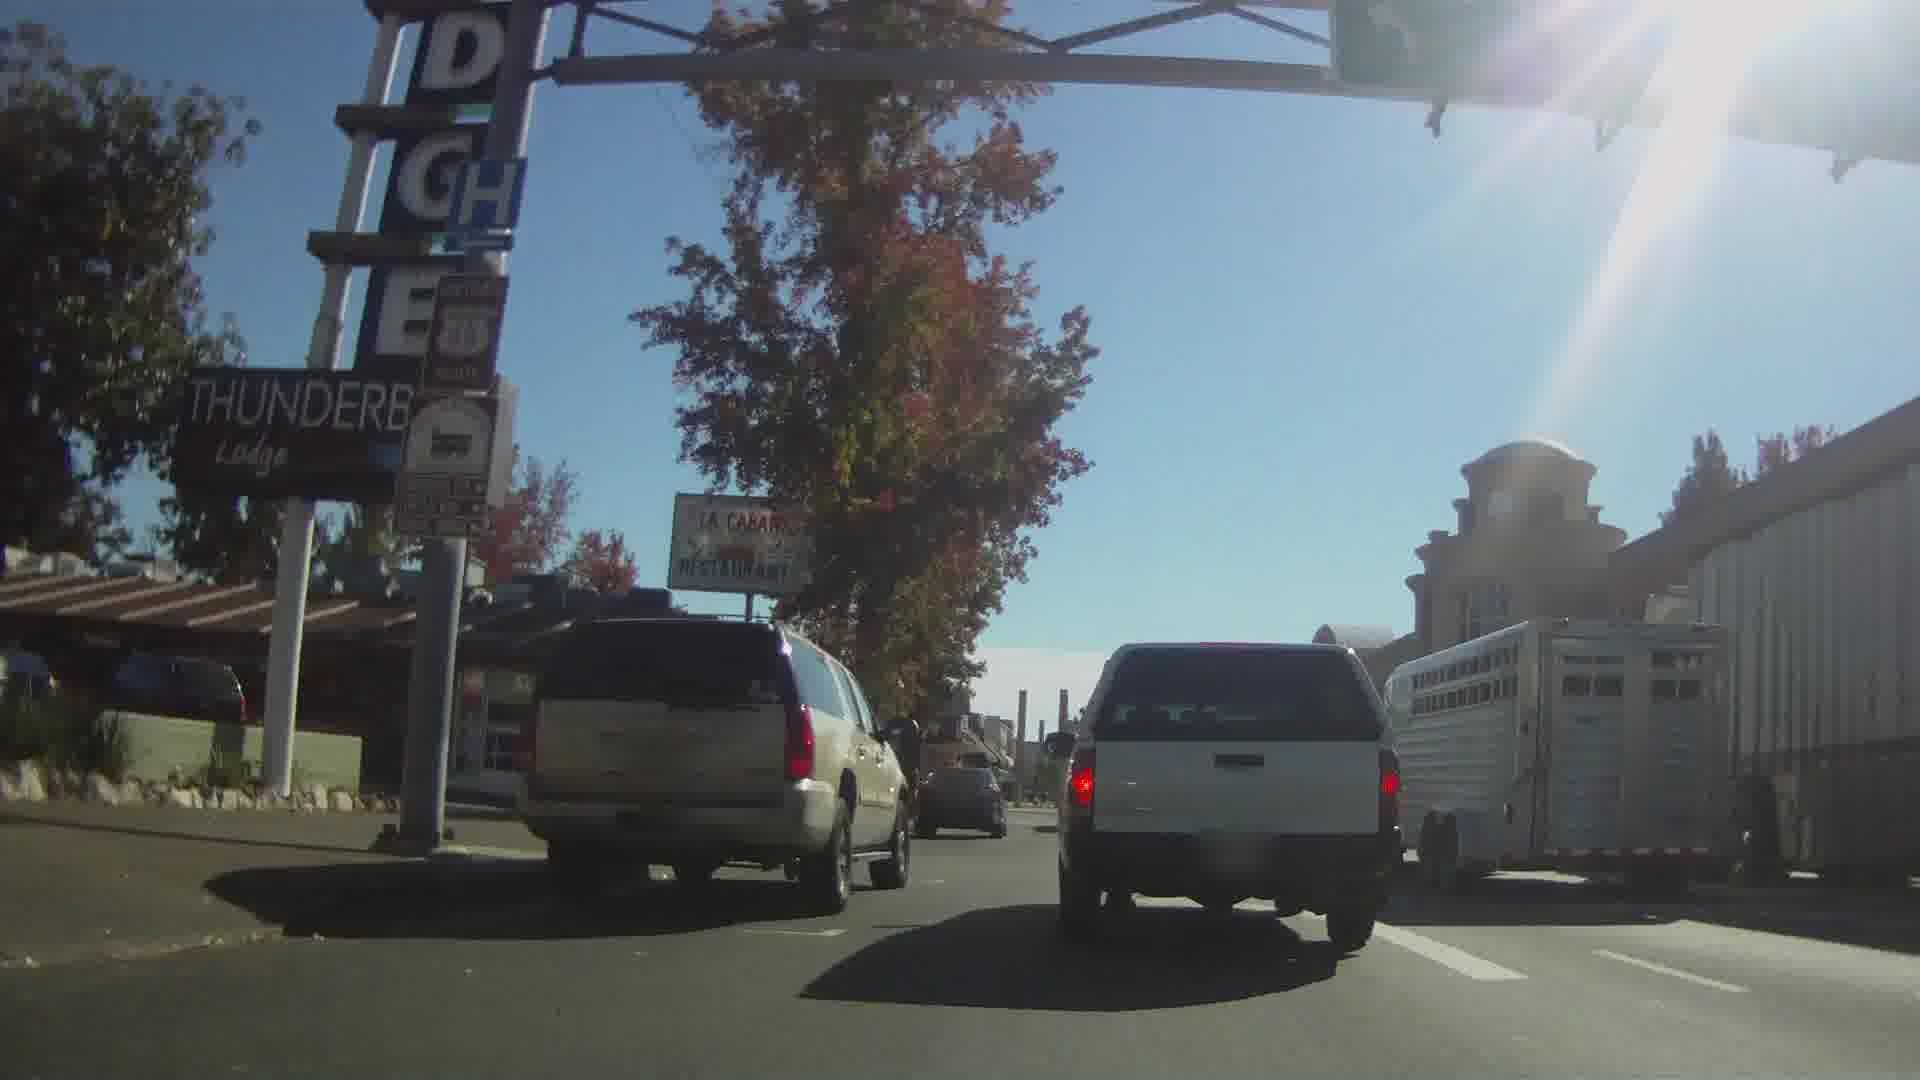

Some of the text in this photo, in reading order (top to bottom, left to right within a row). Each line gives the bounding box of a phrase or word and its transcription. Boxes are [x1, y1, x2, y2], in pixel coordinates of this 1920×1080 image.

[459, 162, 518, 227] H
[191, 376, 415, 431] THUNDERB
[215, 432, 289, 479] Lodge
